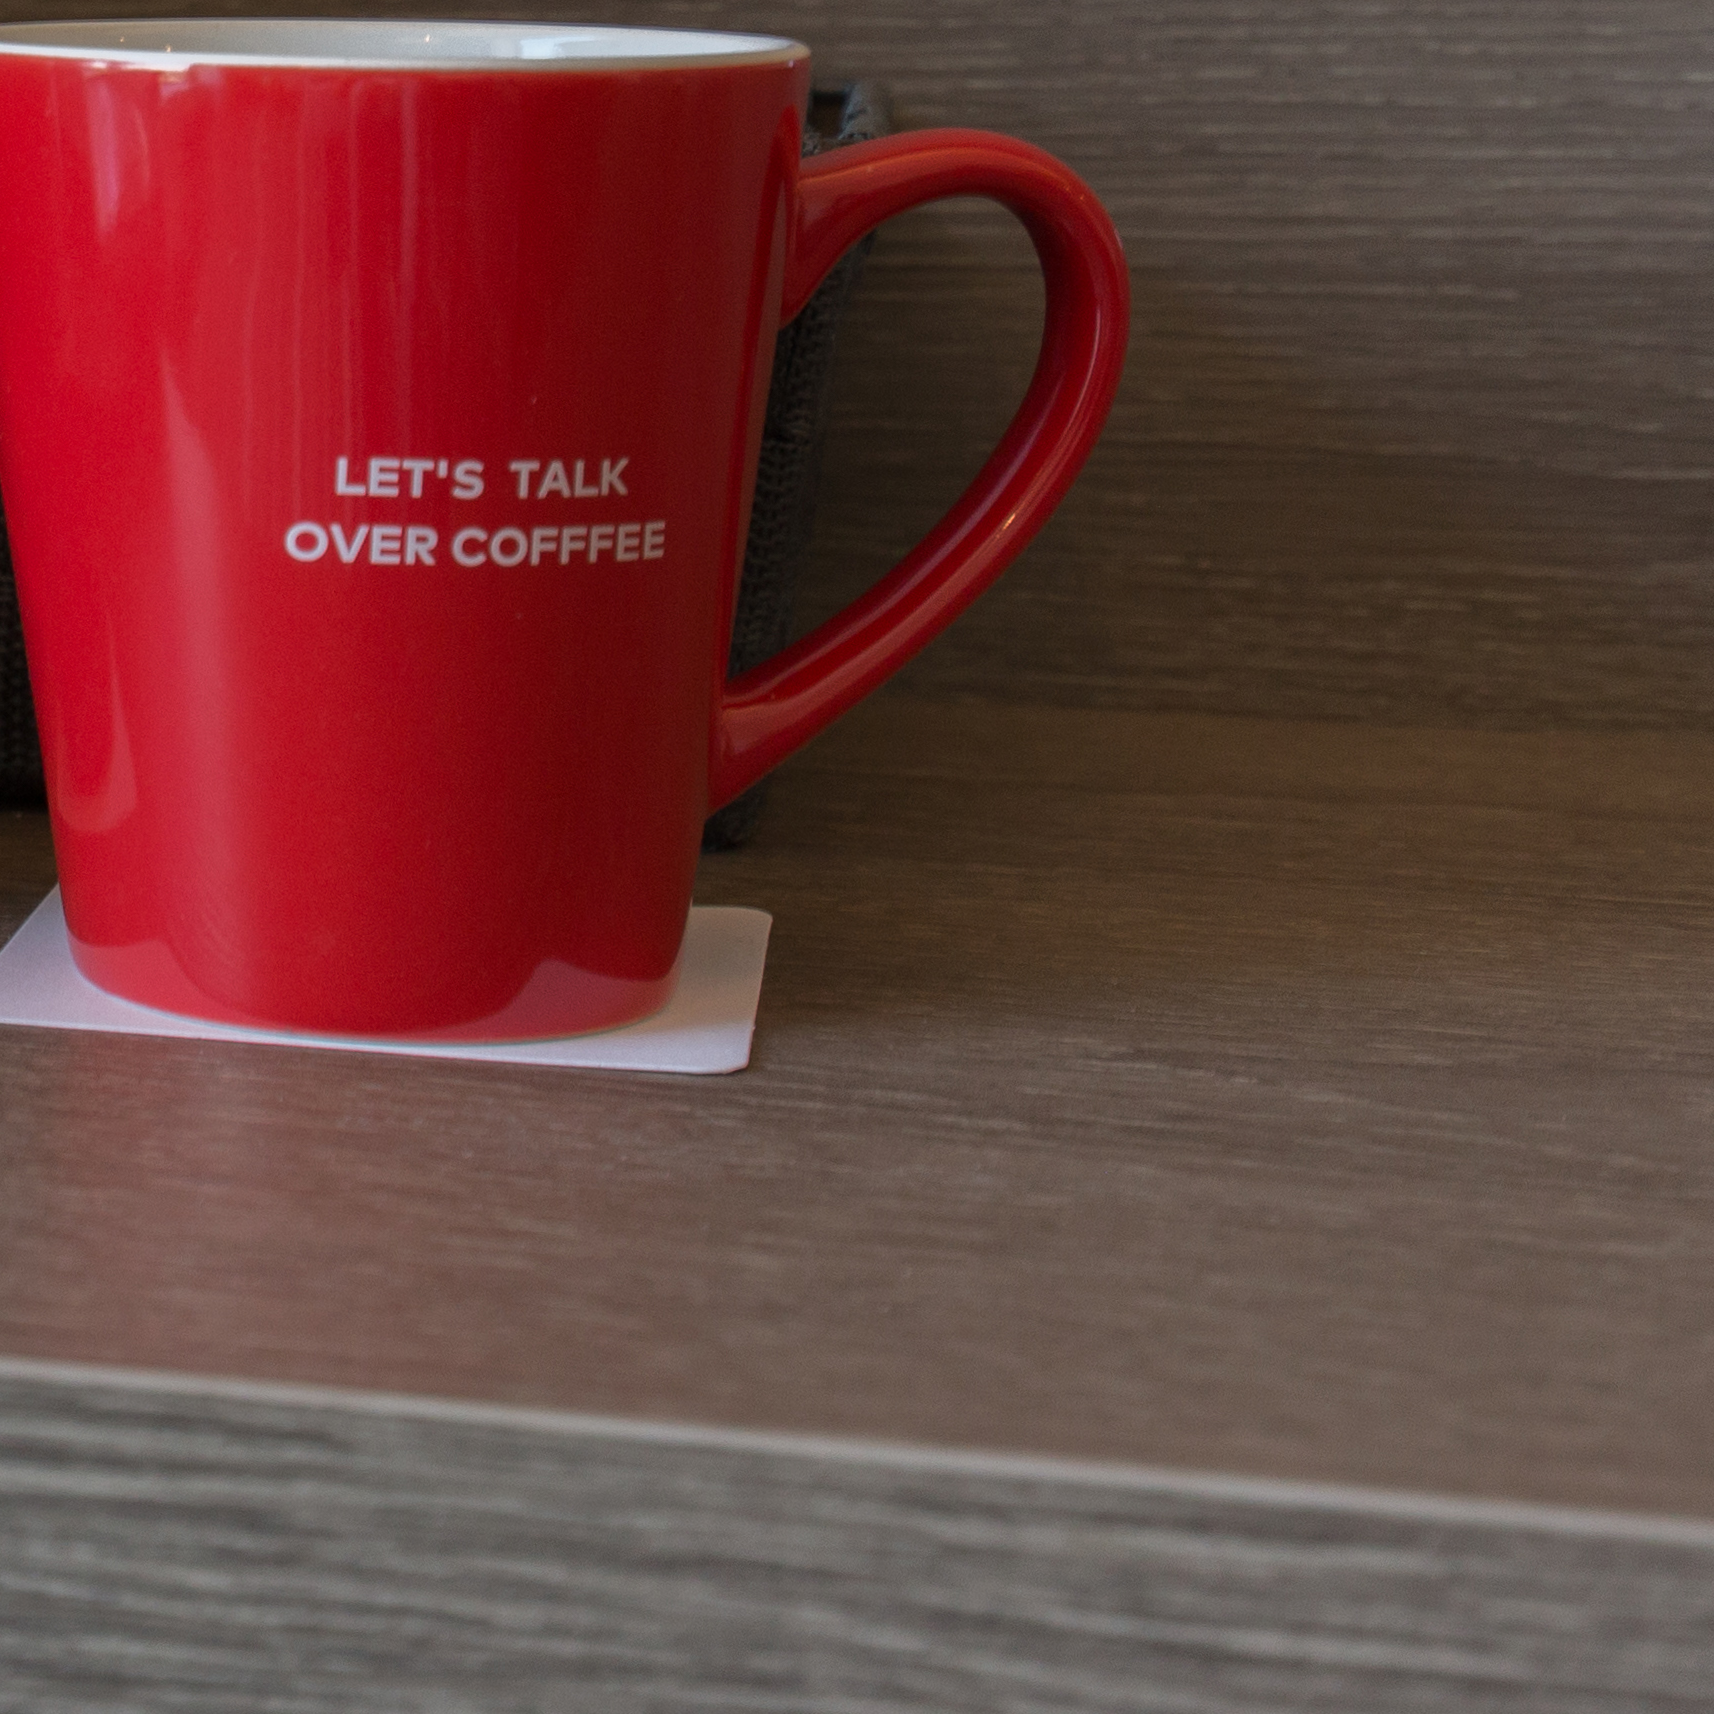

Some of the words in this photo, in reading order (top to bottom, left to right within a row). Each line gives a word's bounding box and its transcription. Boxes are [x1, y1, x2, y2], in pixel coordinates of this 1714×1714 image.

[335, 456, 485, 500] LET'S
[509, 456, 630, 500] TALK
[284, 521, 438, 566] OVER
[451, 520, 666, 567] COFFFEE
